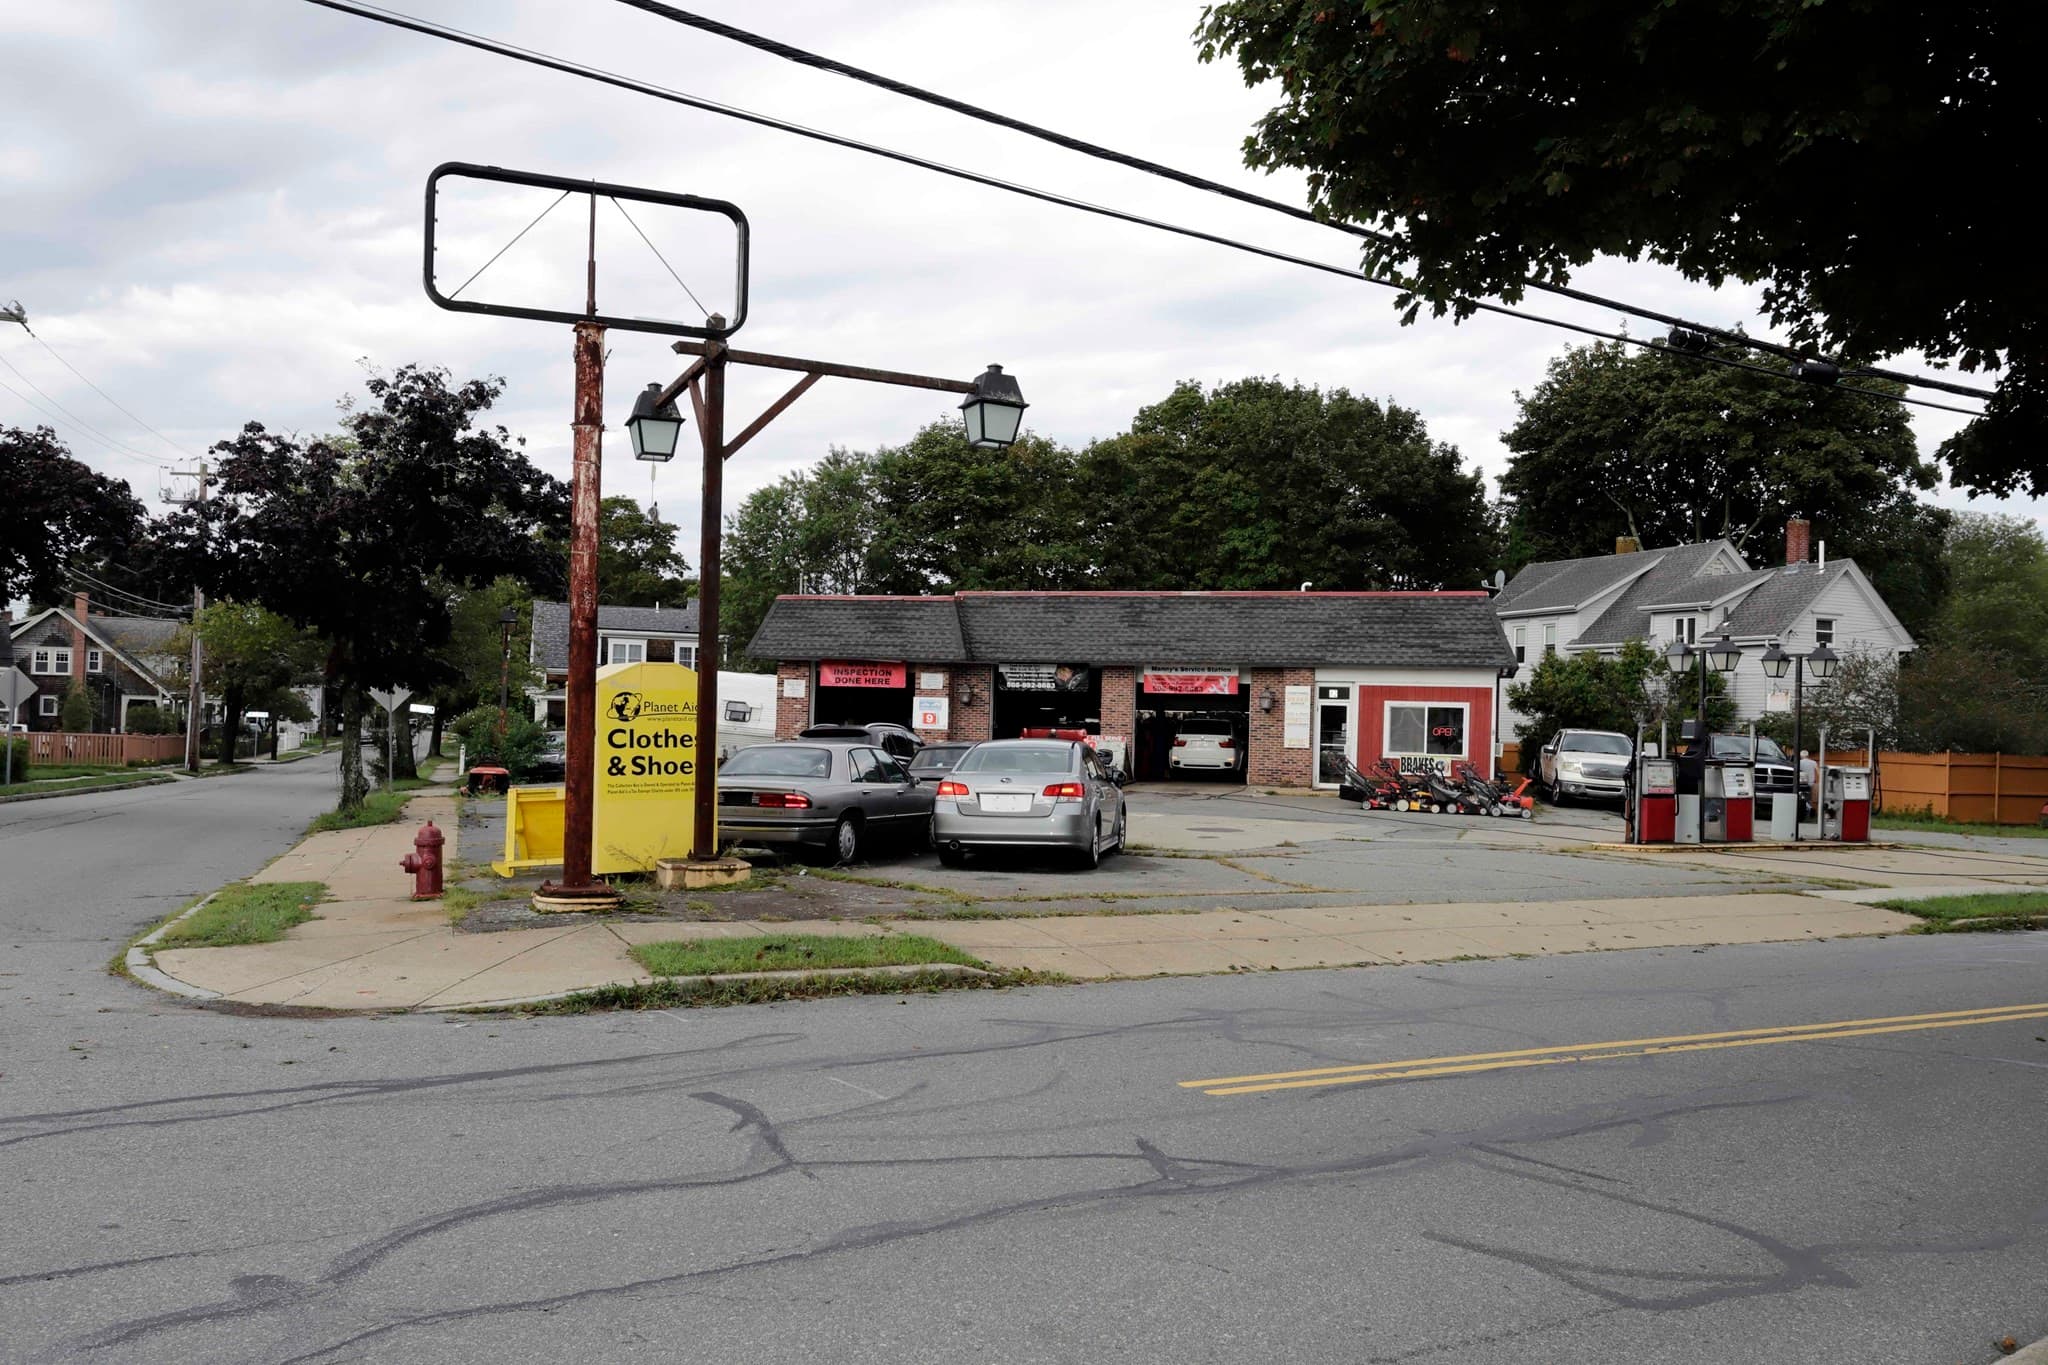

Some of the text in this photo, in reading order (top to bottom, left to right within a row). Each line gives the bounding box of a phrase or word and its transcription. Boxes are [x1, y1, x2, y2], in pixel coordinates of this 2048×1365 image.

[833, 668, 892, 677] INSPECTION
[834, 677, 862, 685] DONE
[643, 701, 678, 712] Planet
[926, 714, 934, 723] 9
[607, 728, 697, 749] Clothe
[607, 755, 696, 776] & Shoe
[1401, 757, 1435, 773] BRAKES
